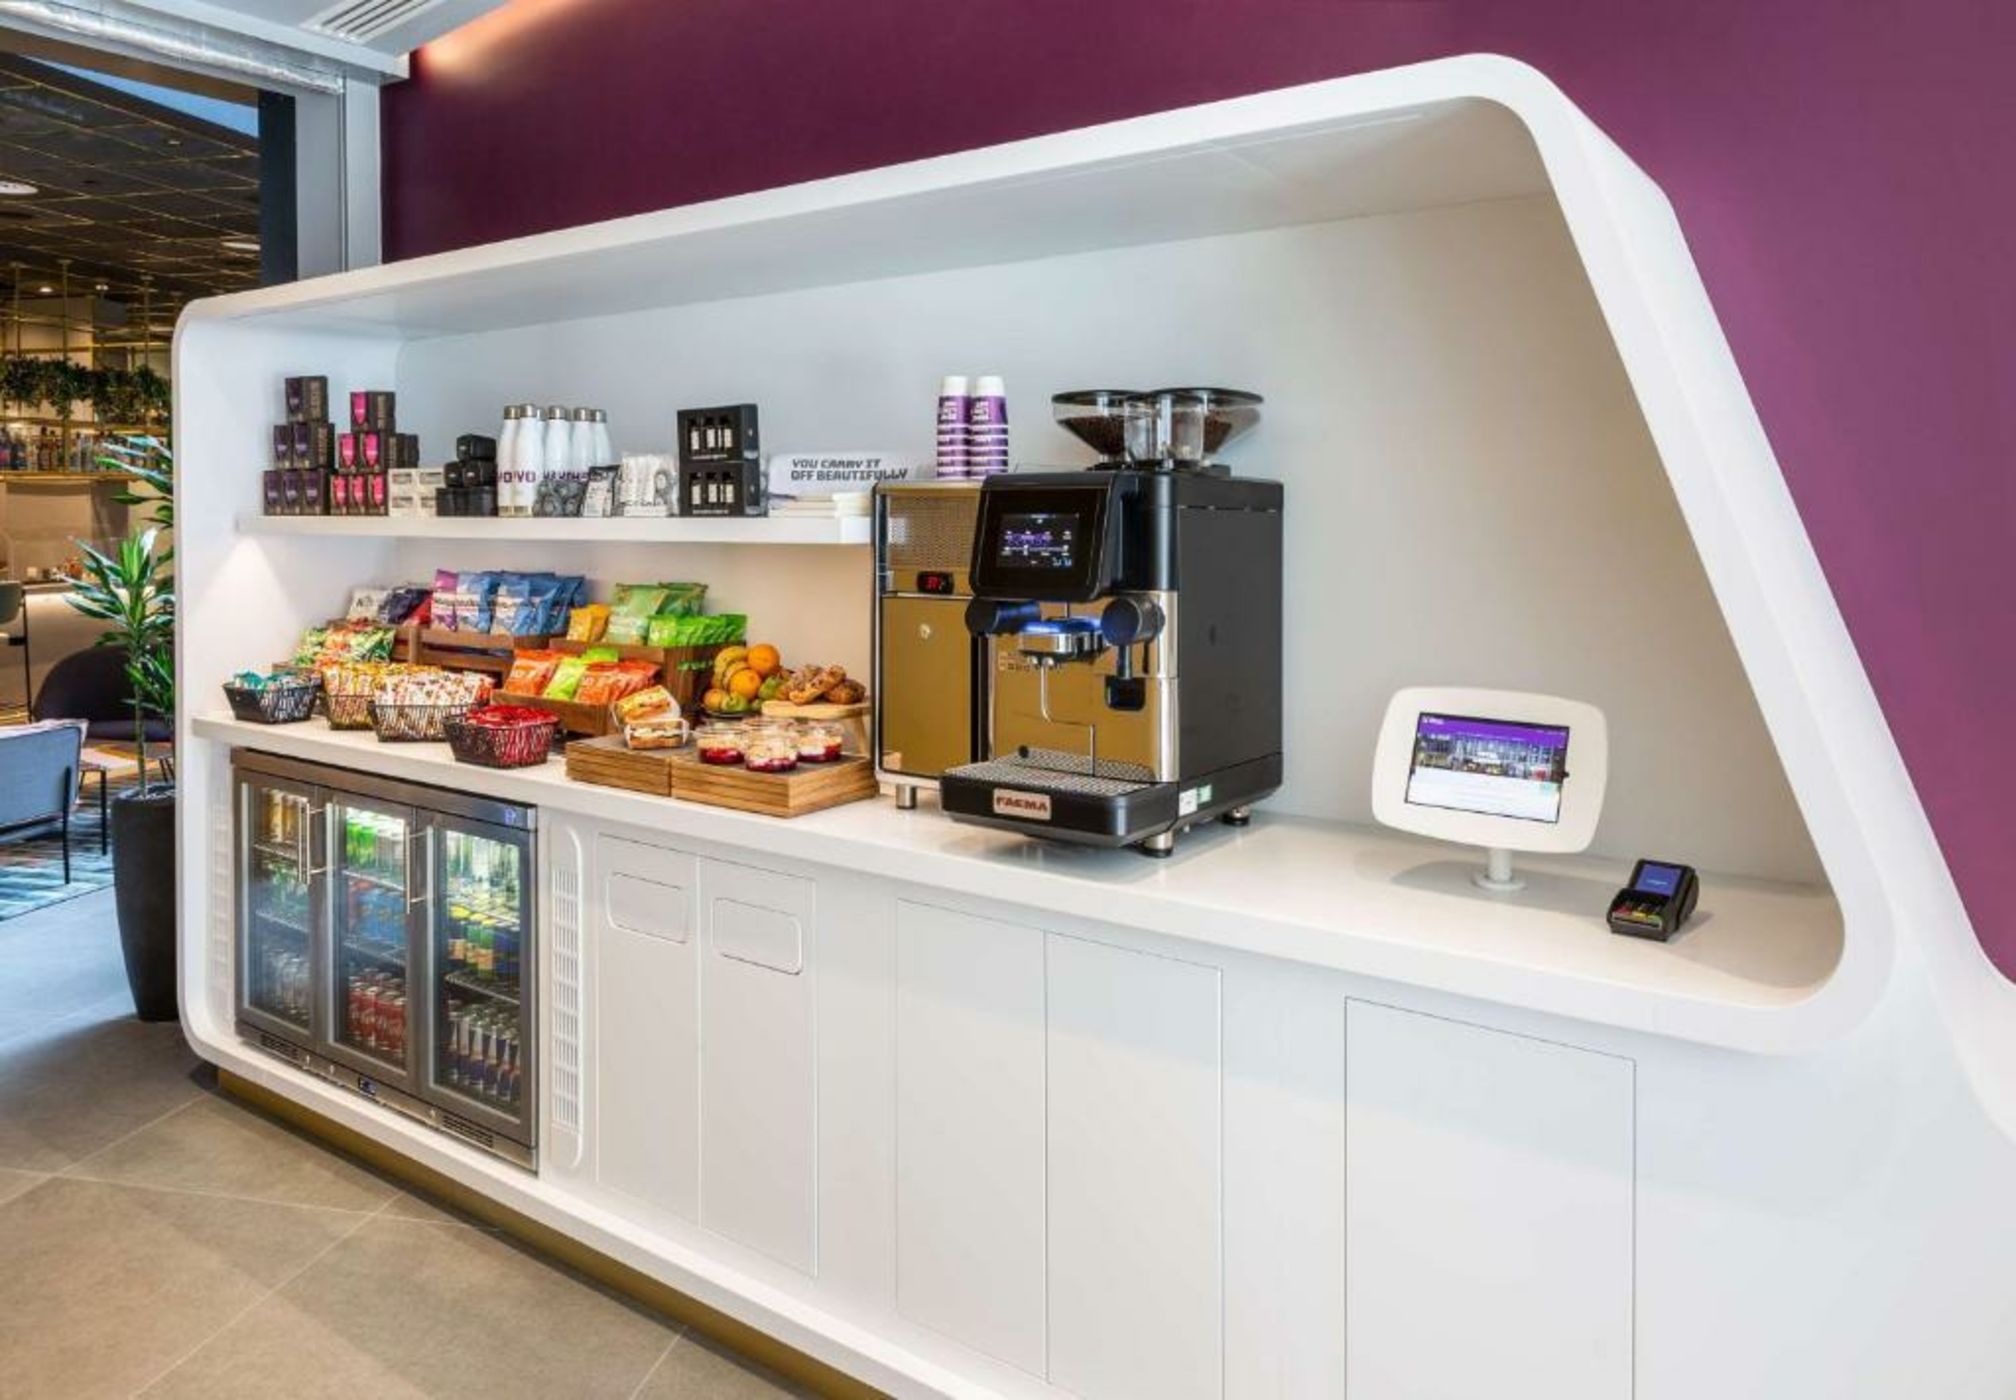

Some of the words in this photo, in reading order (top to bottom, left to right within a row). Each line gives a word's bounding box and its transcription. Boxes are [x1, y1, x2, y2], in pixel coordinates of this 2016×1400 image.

[792, 458, 818, 469] YOU
[820, 458, 863, 469] CARRY
[866, 458, 881, 469] IT
[791, 469, 813, 480] OFF
[816, 468, 908, 480] BEAUTIFULLY
[996, 796, 1048, 812] FAEMA
